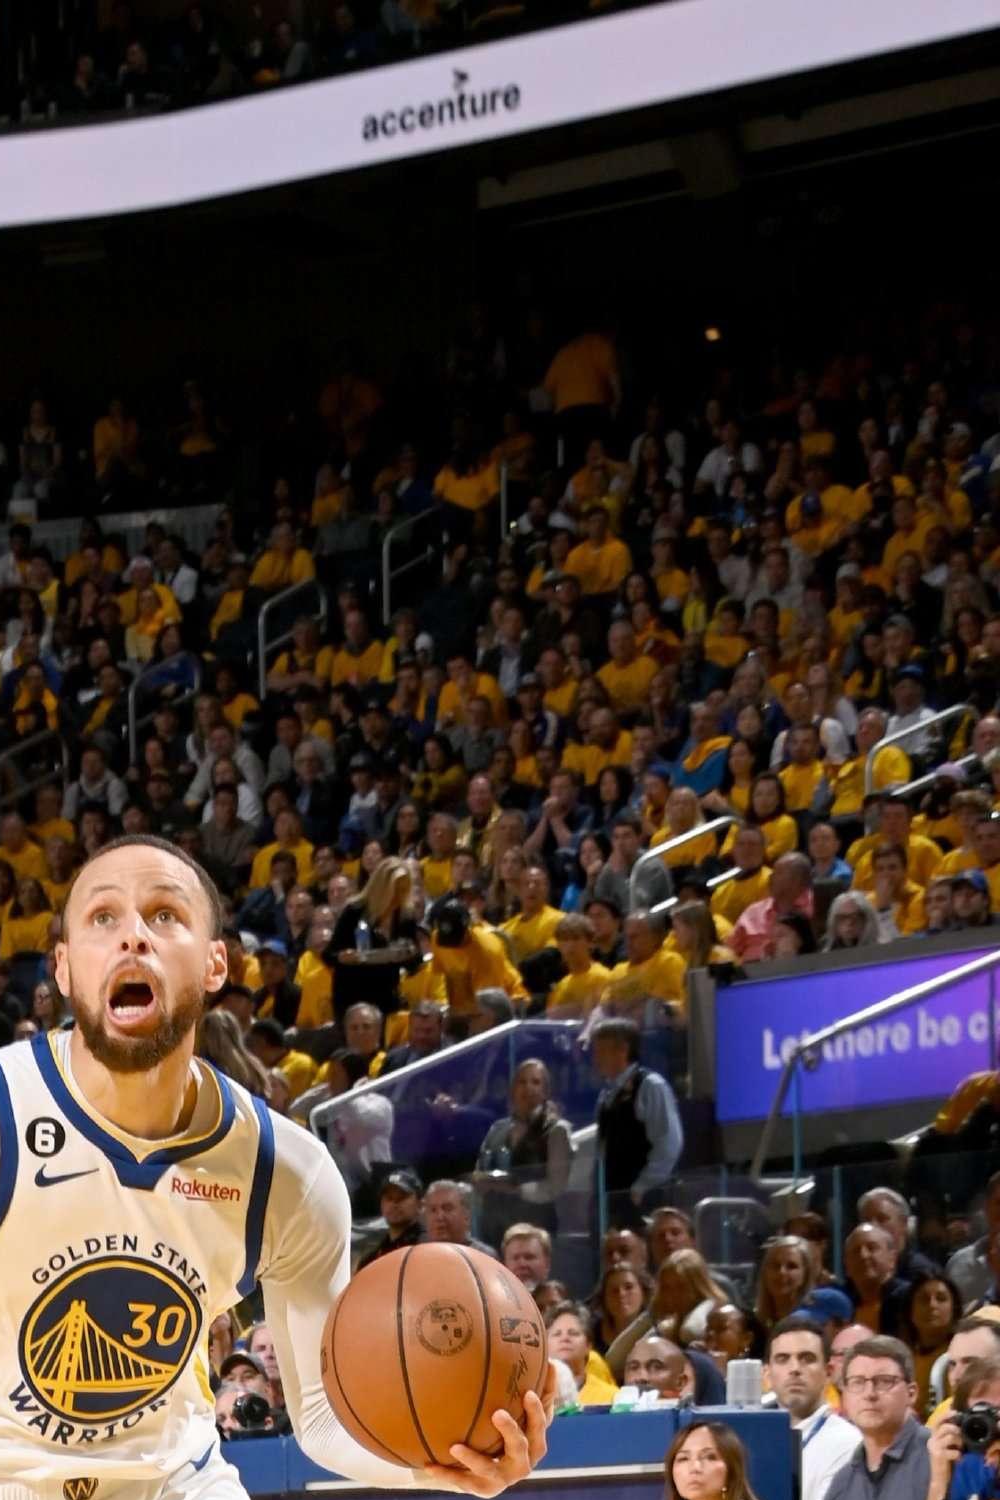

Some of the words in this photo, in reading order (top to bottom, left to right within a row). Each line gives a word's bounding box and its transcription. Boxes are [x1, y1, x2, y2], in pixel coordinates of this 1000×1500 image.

[362, 83, 521, 141] accenture
[918, 1008, 961, 1049] be
[34, 1120, 56, 1154] 6
[171, 1177, 241, 1201] Rakuten
[31, 1234, 138, 1285] GOLDEN
[151, 1241, 208, 1300] STATE
[122, 1302, 187, 1348] 30
